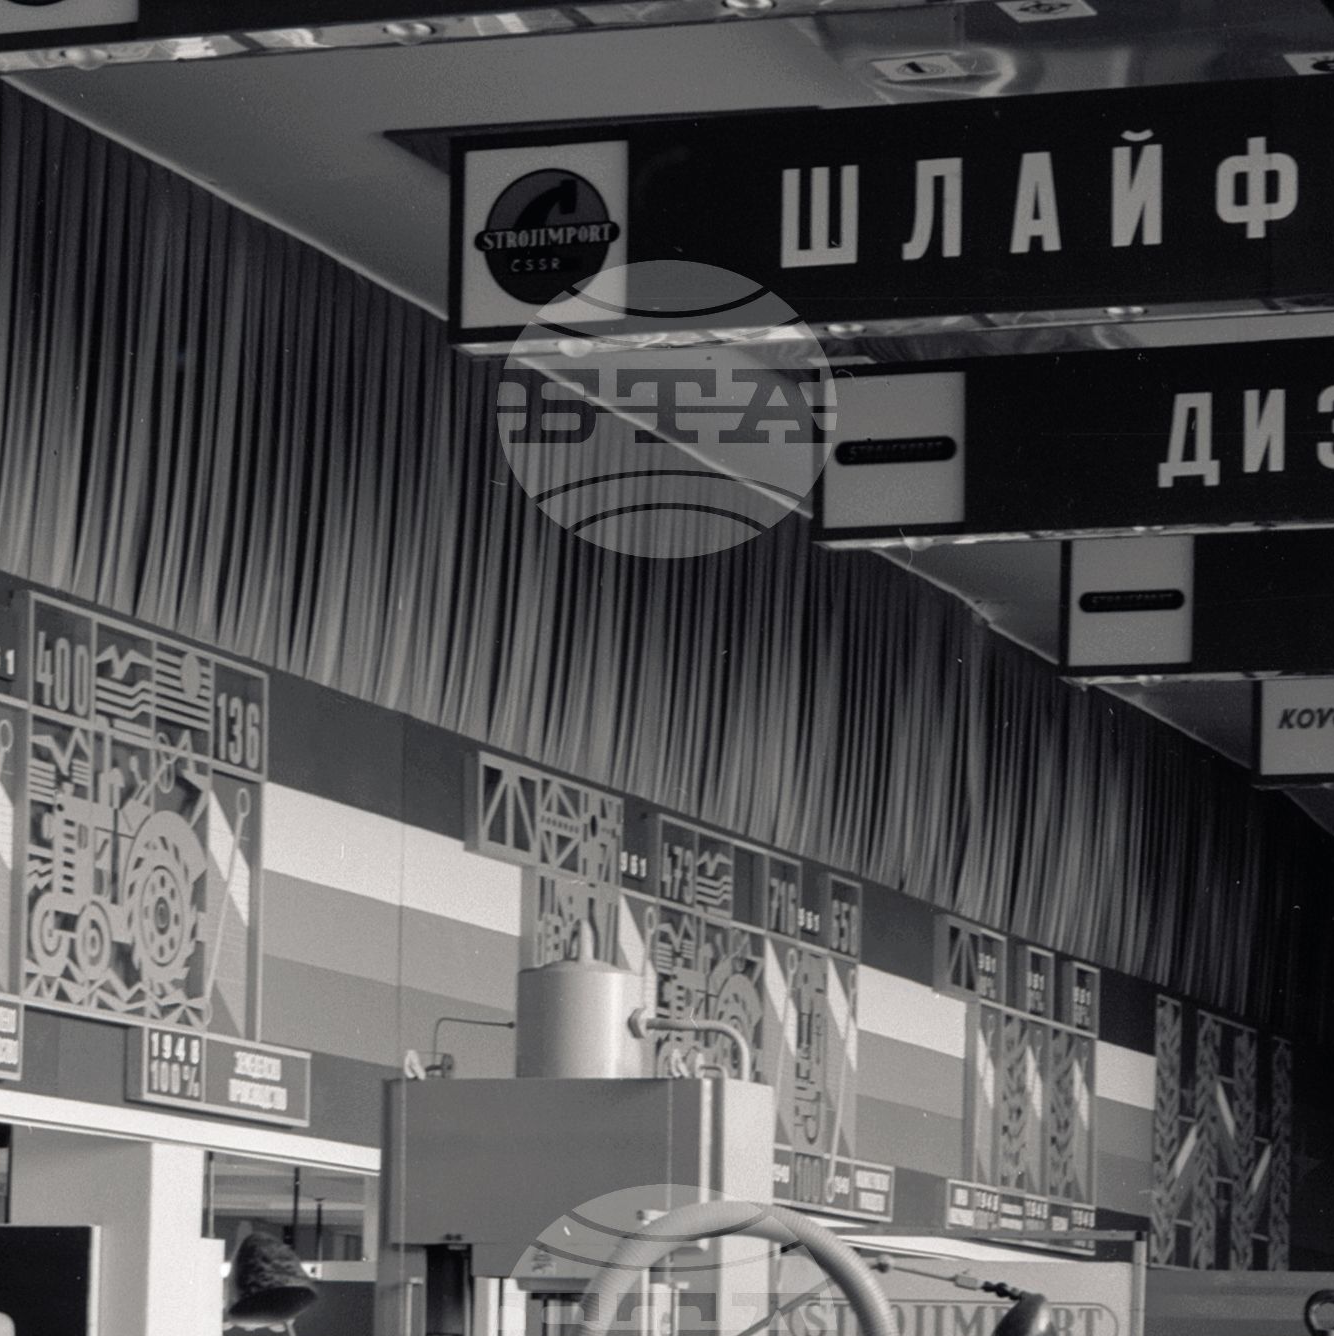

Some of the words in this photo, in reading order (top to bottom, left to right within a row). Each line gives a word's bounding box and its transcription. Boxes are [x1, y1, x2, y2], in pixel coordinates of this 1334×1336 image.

[482, 222, 613, 250] STROJIMPORT
[510, 257, 562, 273] CSSR
[34, 631, 90, 716] 400
[216, 692, 261, 770] 136
